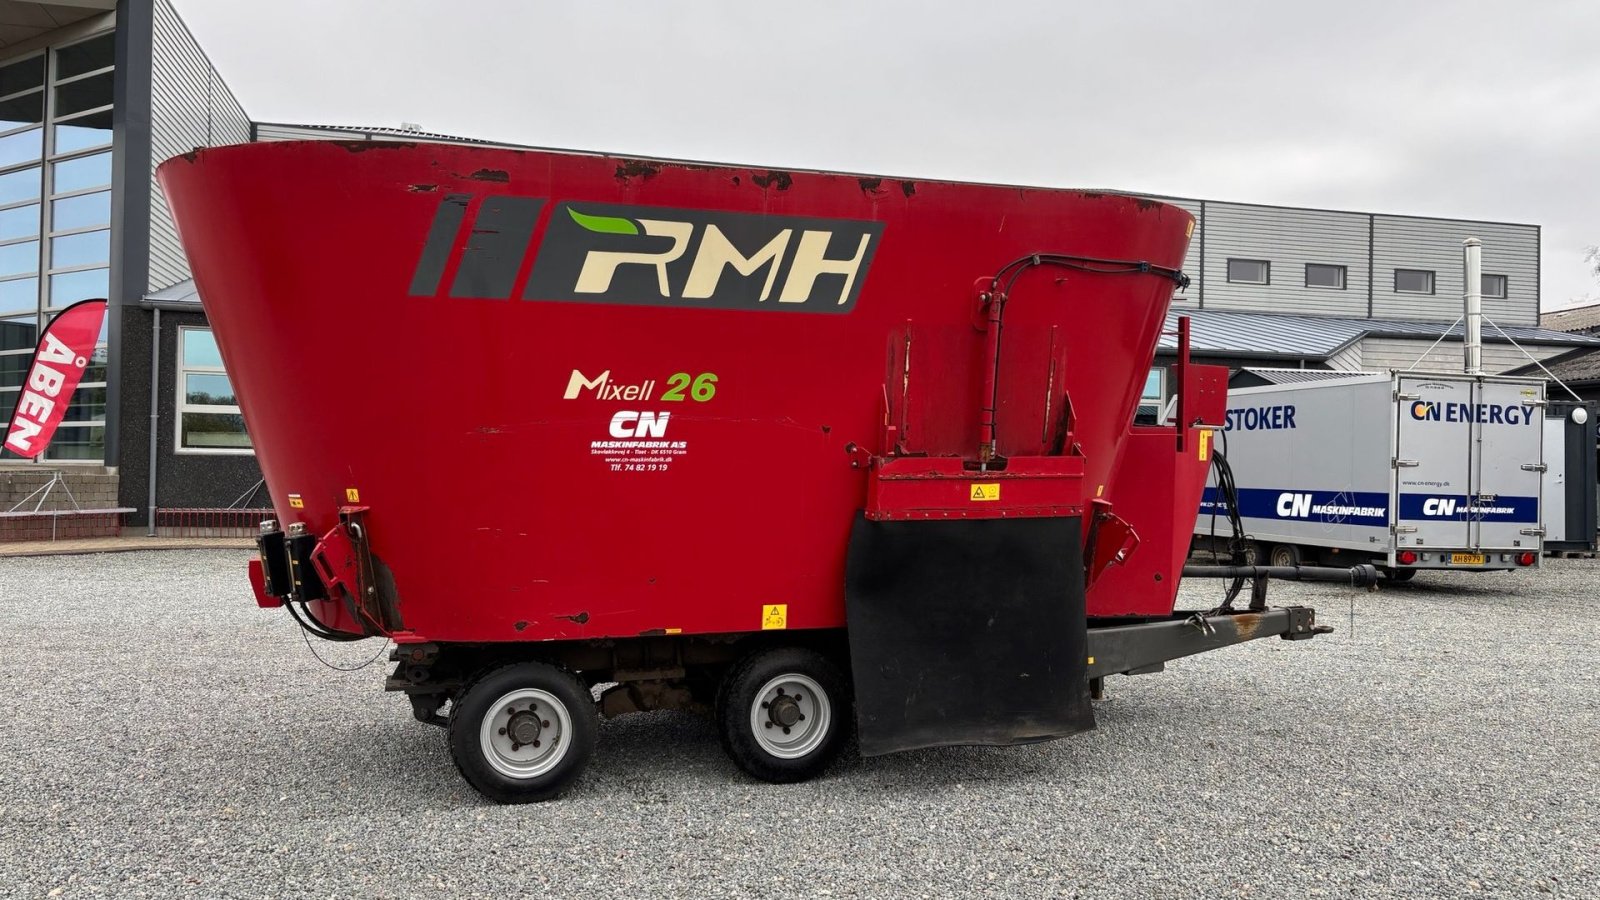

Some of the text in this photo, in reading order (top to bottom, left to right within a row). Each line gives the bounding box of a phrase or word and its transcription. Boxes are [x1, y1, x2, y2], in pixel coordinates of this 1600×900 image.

[566, 205, 871, 305] RMH
[6, 331, 86, 451] ÅBEN
[563, 369, 718, 402] Mixell 26
[609, 410, 670, 438] CN
[1446, 402, 1534, 425] ENERGY
[591, 441, 669, 449] MASKINFABRIK
[1277, 493, 1385, 517] CN MASKINFABRIK
[1423, 498, 1456, 516] CN
